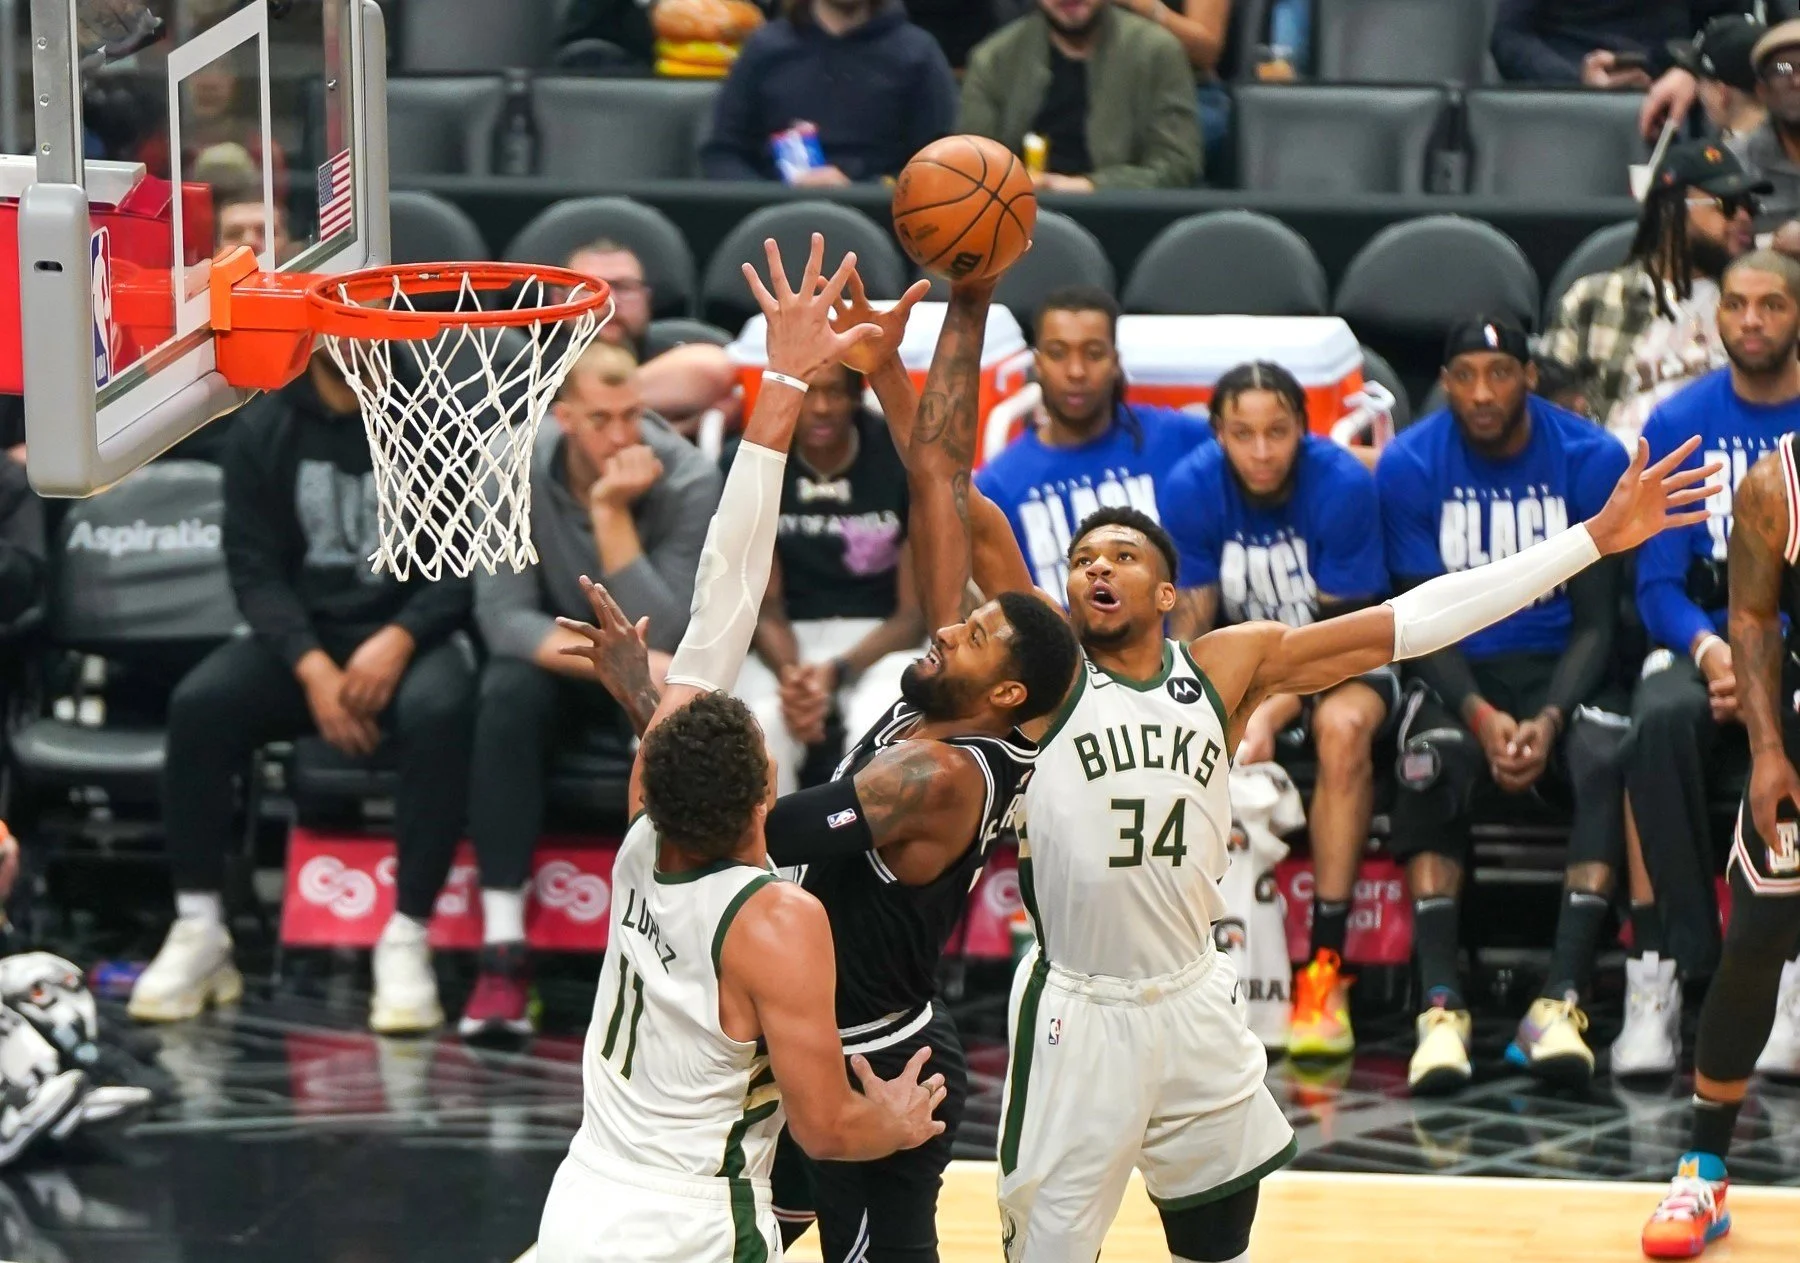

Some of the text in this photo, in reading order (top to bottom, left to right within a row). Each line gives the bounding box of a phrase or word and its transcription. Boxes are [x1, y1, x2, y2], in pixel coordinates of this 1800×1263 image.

[66, 517, 222, 557] Aspiratio
[1073, 723, 1222, 789] BUCKS
[1108, 797, 1188, 868] 34
[600, 952, 645, 1081] 11
